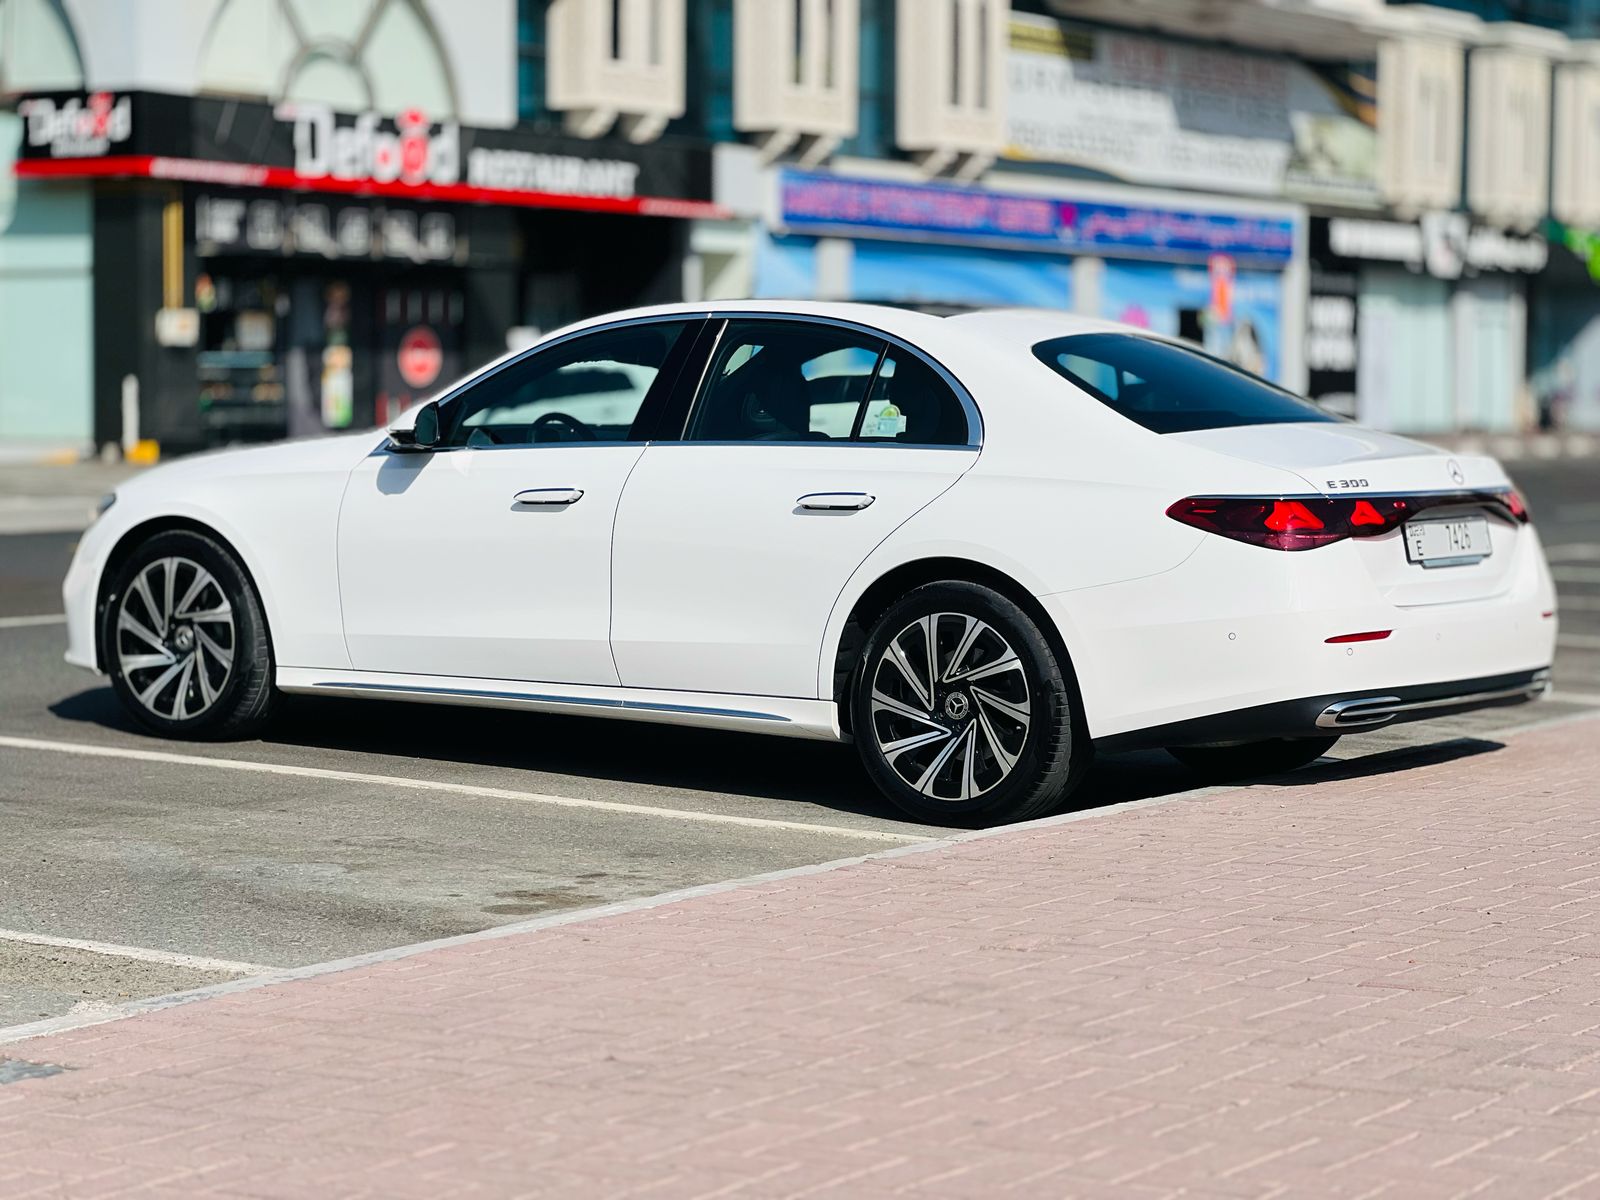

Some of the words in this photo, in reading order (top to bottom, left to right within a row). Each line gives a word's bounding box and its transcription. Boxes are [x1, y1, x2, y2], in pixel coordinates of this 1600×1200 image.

[276, 104, 461, 188] Defood
[467, 147, 640, 199] RESTAURANT
[1326, 480, 1338, 489] E
[1339, 478, 1369, 489] 300
[1416, 540, 1424, 556] E
[1446, 521, 1472, 552] 7426
